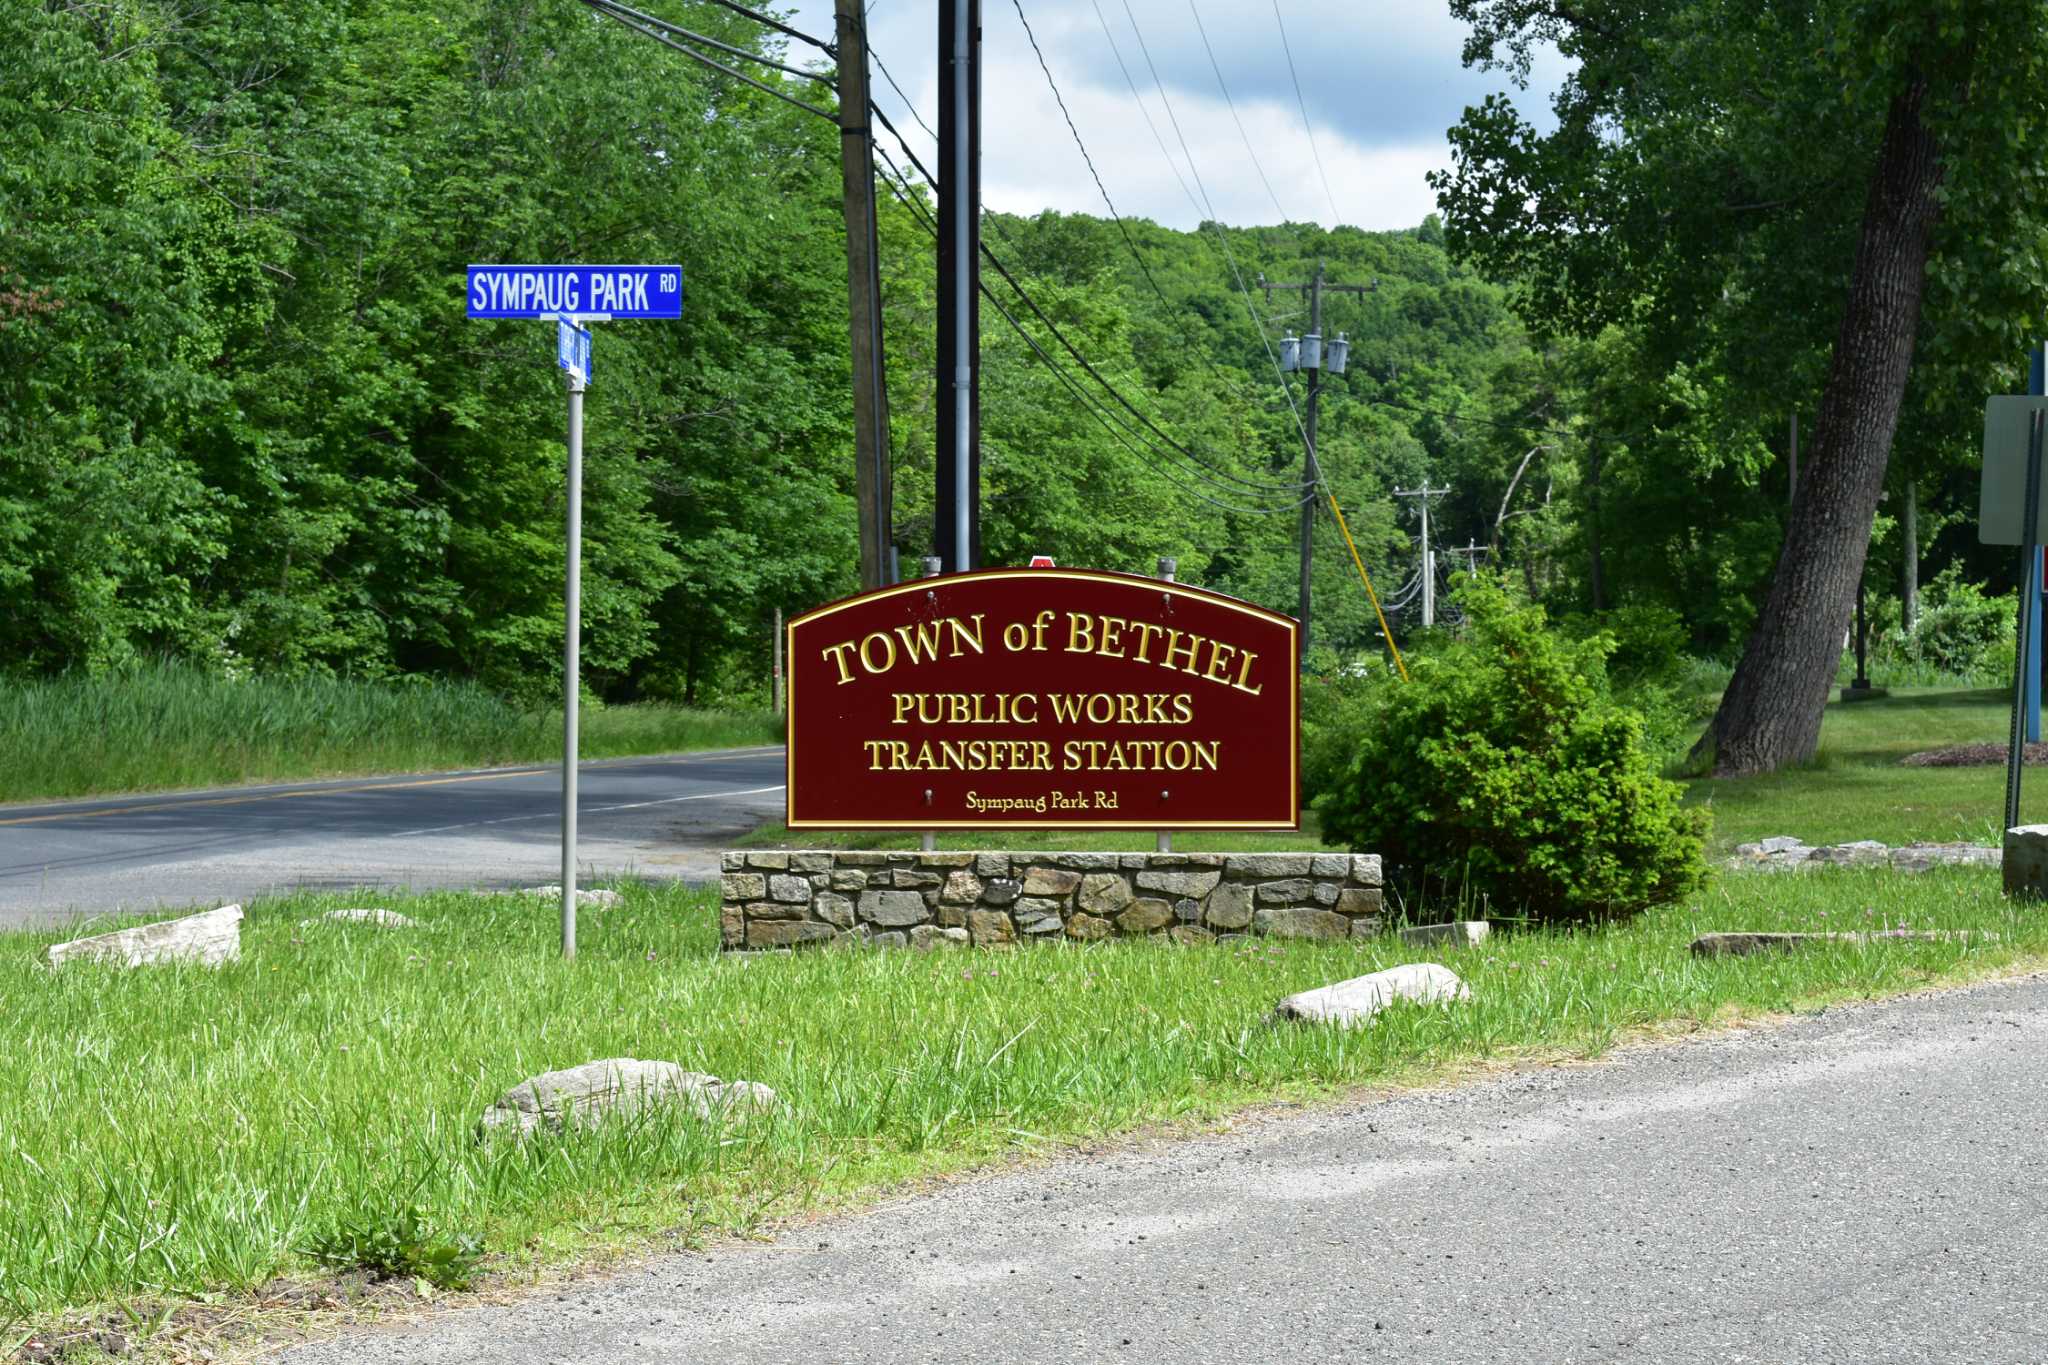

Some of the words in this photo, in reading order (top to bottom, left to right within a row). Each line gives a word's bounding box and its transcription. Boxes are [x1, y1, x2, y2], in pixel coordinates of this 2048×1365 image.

[472, 272, 580, 311] SYMPAUG
[590, 272, 650, 311] PARK
[659, 273, 677, 293] RD
[821, 613, 986, 686] TOWN
[1003, 609, 1056, 652] of
[1063, 612, 1264, 696] BETHEL
[891, 693, 1039, 724] PUBLIC
[1046, 693, 1194, 725] WORKS
[863, 740, 1055, 771] TRANSFER
[1063, 740, 1222, 771] STATION
[965, 790, 1047, 813] Sympaug
[1050, 790, 1090, 810] Park
[1093, 790, 1119, 810] Rd
